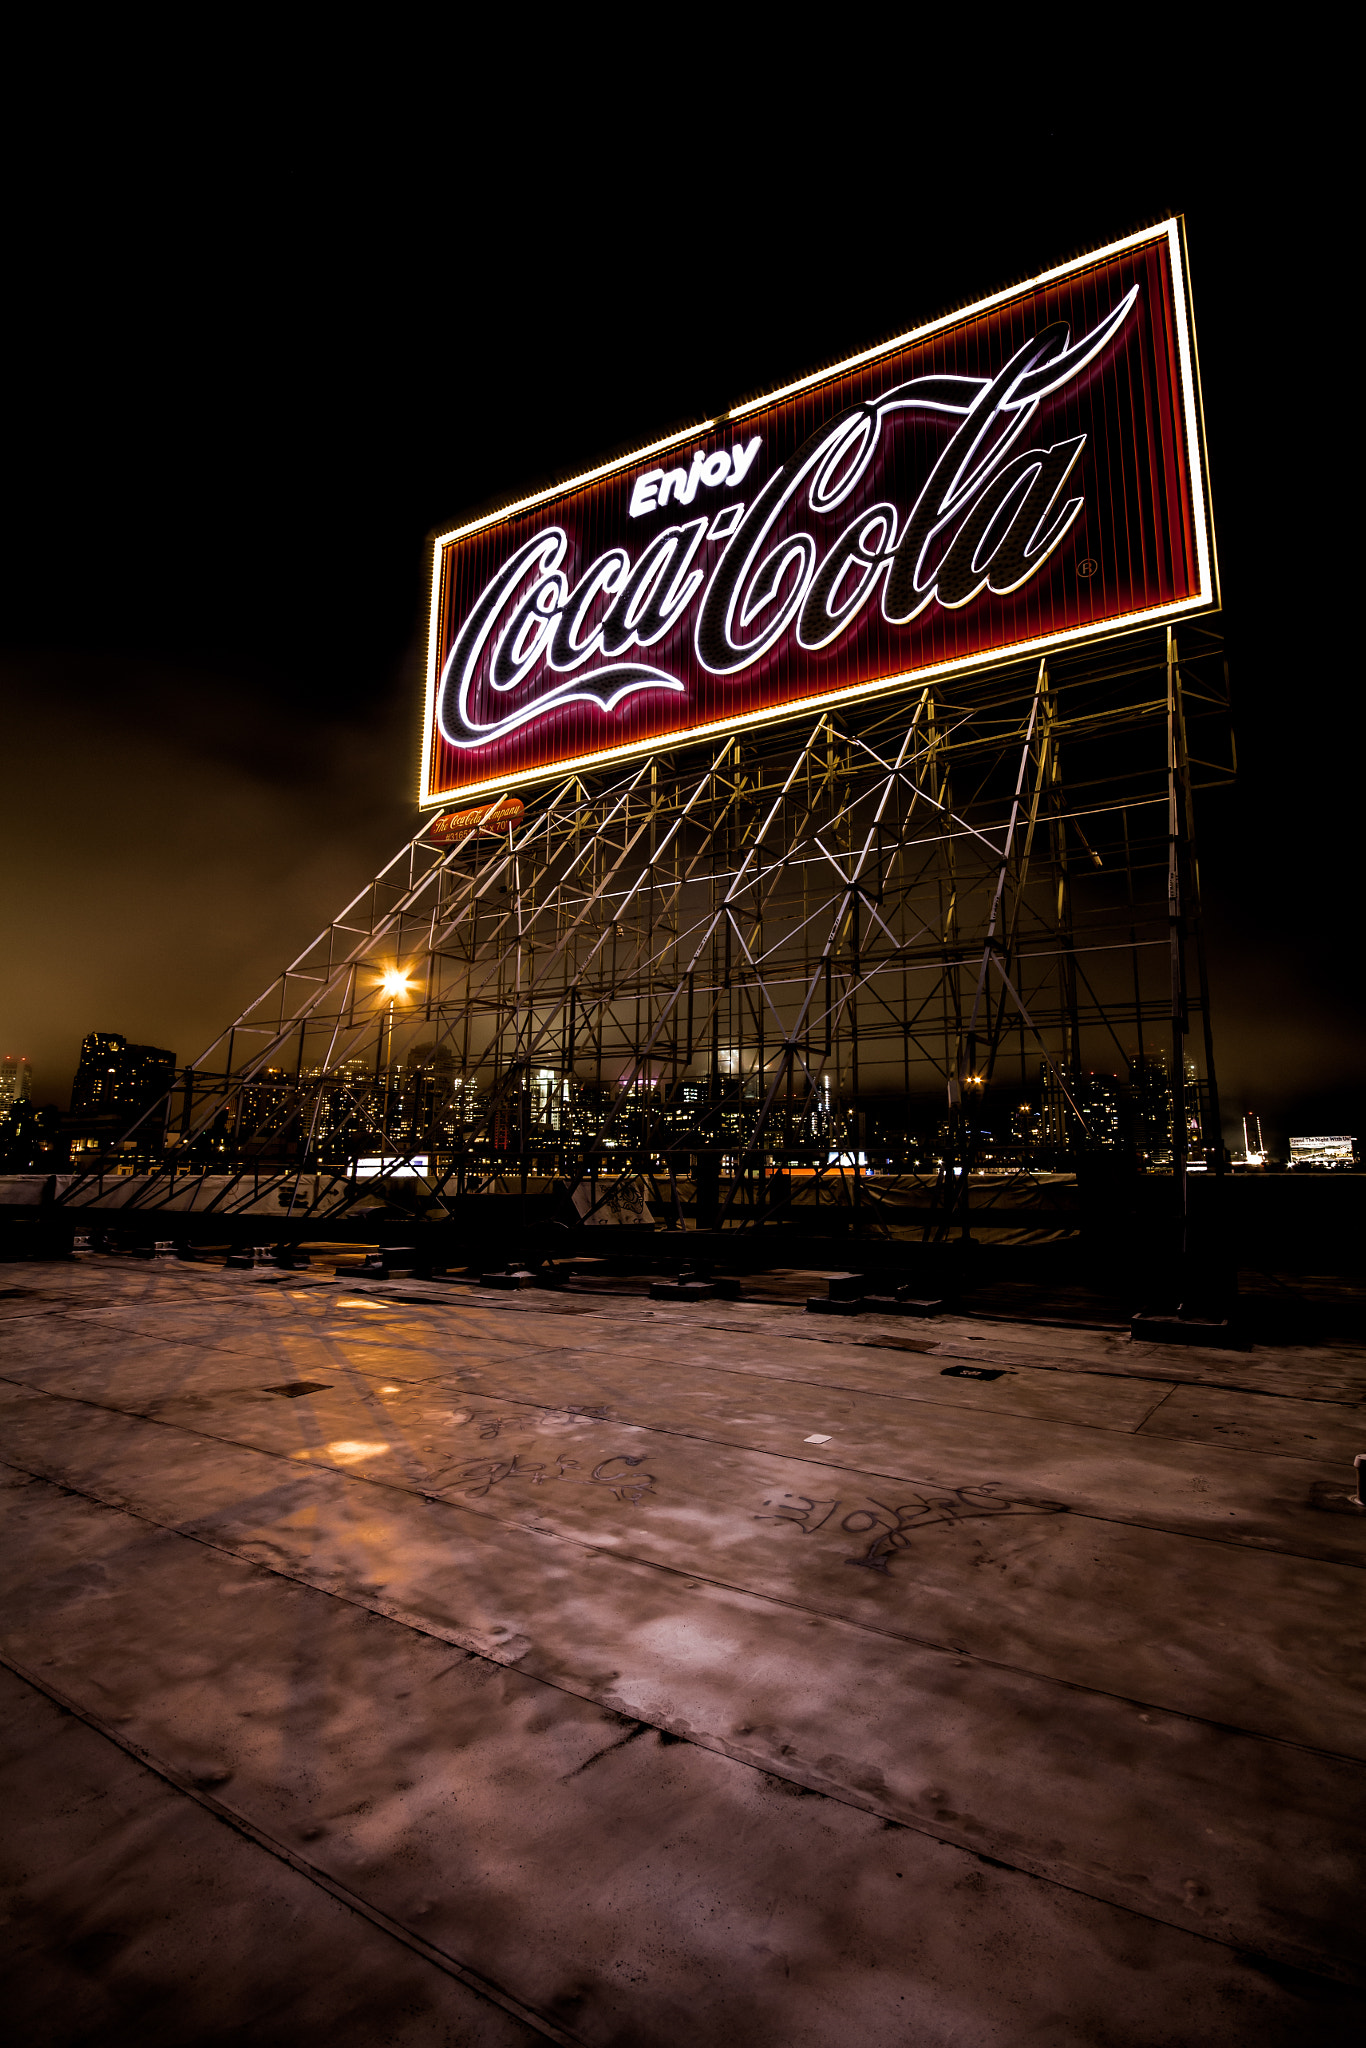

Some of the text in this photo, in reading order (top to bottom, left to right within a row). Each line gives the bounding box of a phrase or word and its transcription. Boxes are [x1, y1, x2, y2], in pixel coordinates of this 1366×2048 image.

[629, 435, 763, 519] Enjoy
[436, 283, 1139, 749] Coca-Cola
[433, 818, 449, 833] The
[484, 805, 520, 821] Cmpany
[496, 820, 508, 831] 70'
